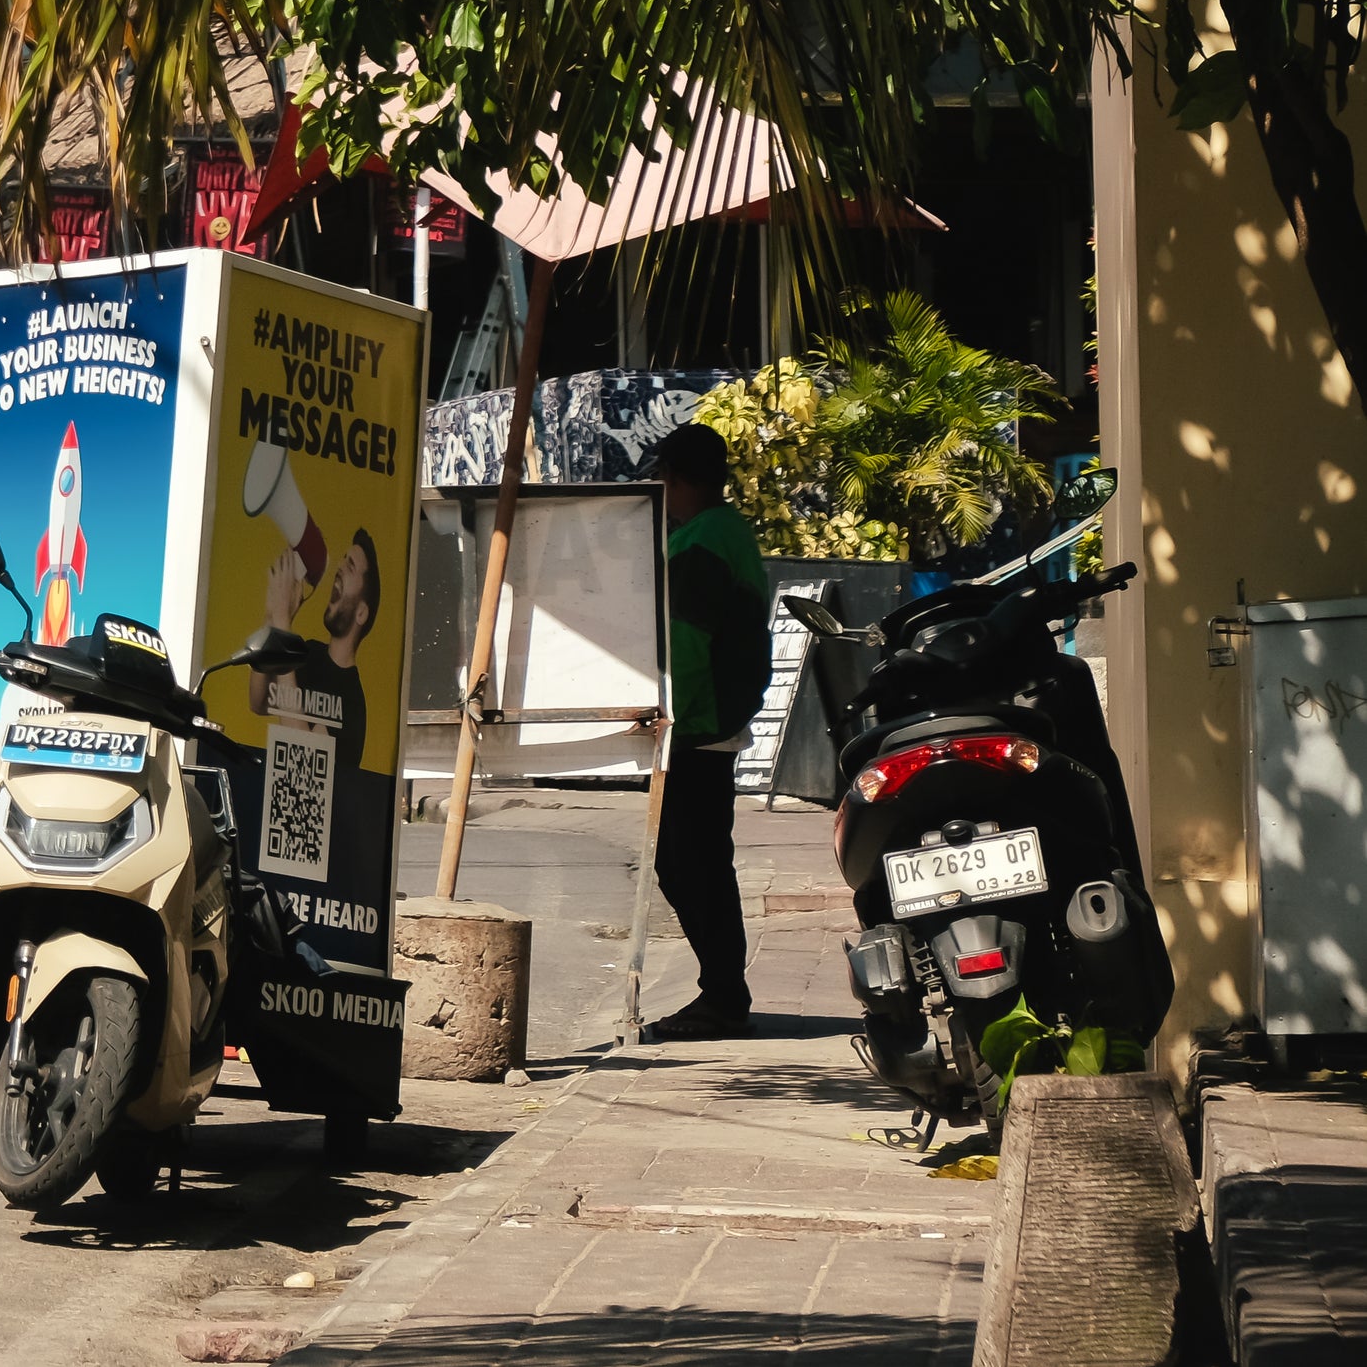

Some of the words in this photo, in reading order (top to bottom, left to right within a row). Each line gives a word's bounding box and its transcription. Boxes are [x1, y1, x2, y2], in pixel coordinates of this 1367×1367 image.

[27, 302, 128, 340] #LAUNCH
[0, 338, 58, 380] YOUR
[63, 334, 157, 369] BUSINESS
[253, 308, 385, 379] #AMPLIFY
[19, 368, 69, 405] NEW
[73, 365, 167, 406] HEIGHTS!
[282, 355, 355, 413] YOUR
[239, 387, 397, 477] MESSAGE!
[304, 689, 343, 721] MEDIA
[12, 725, 138, 753] DK2282FDX
[895, 859, 925, 884] DK
[932, 848, 987, 877] 2629
[313, 896, 379, 934] HEARD
[905, 898, 937, 911] YAMAHA
[260, 982, 325, 1018] SKOO
[332, 991, 405, 1031] MEDIA
